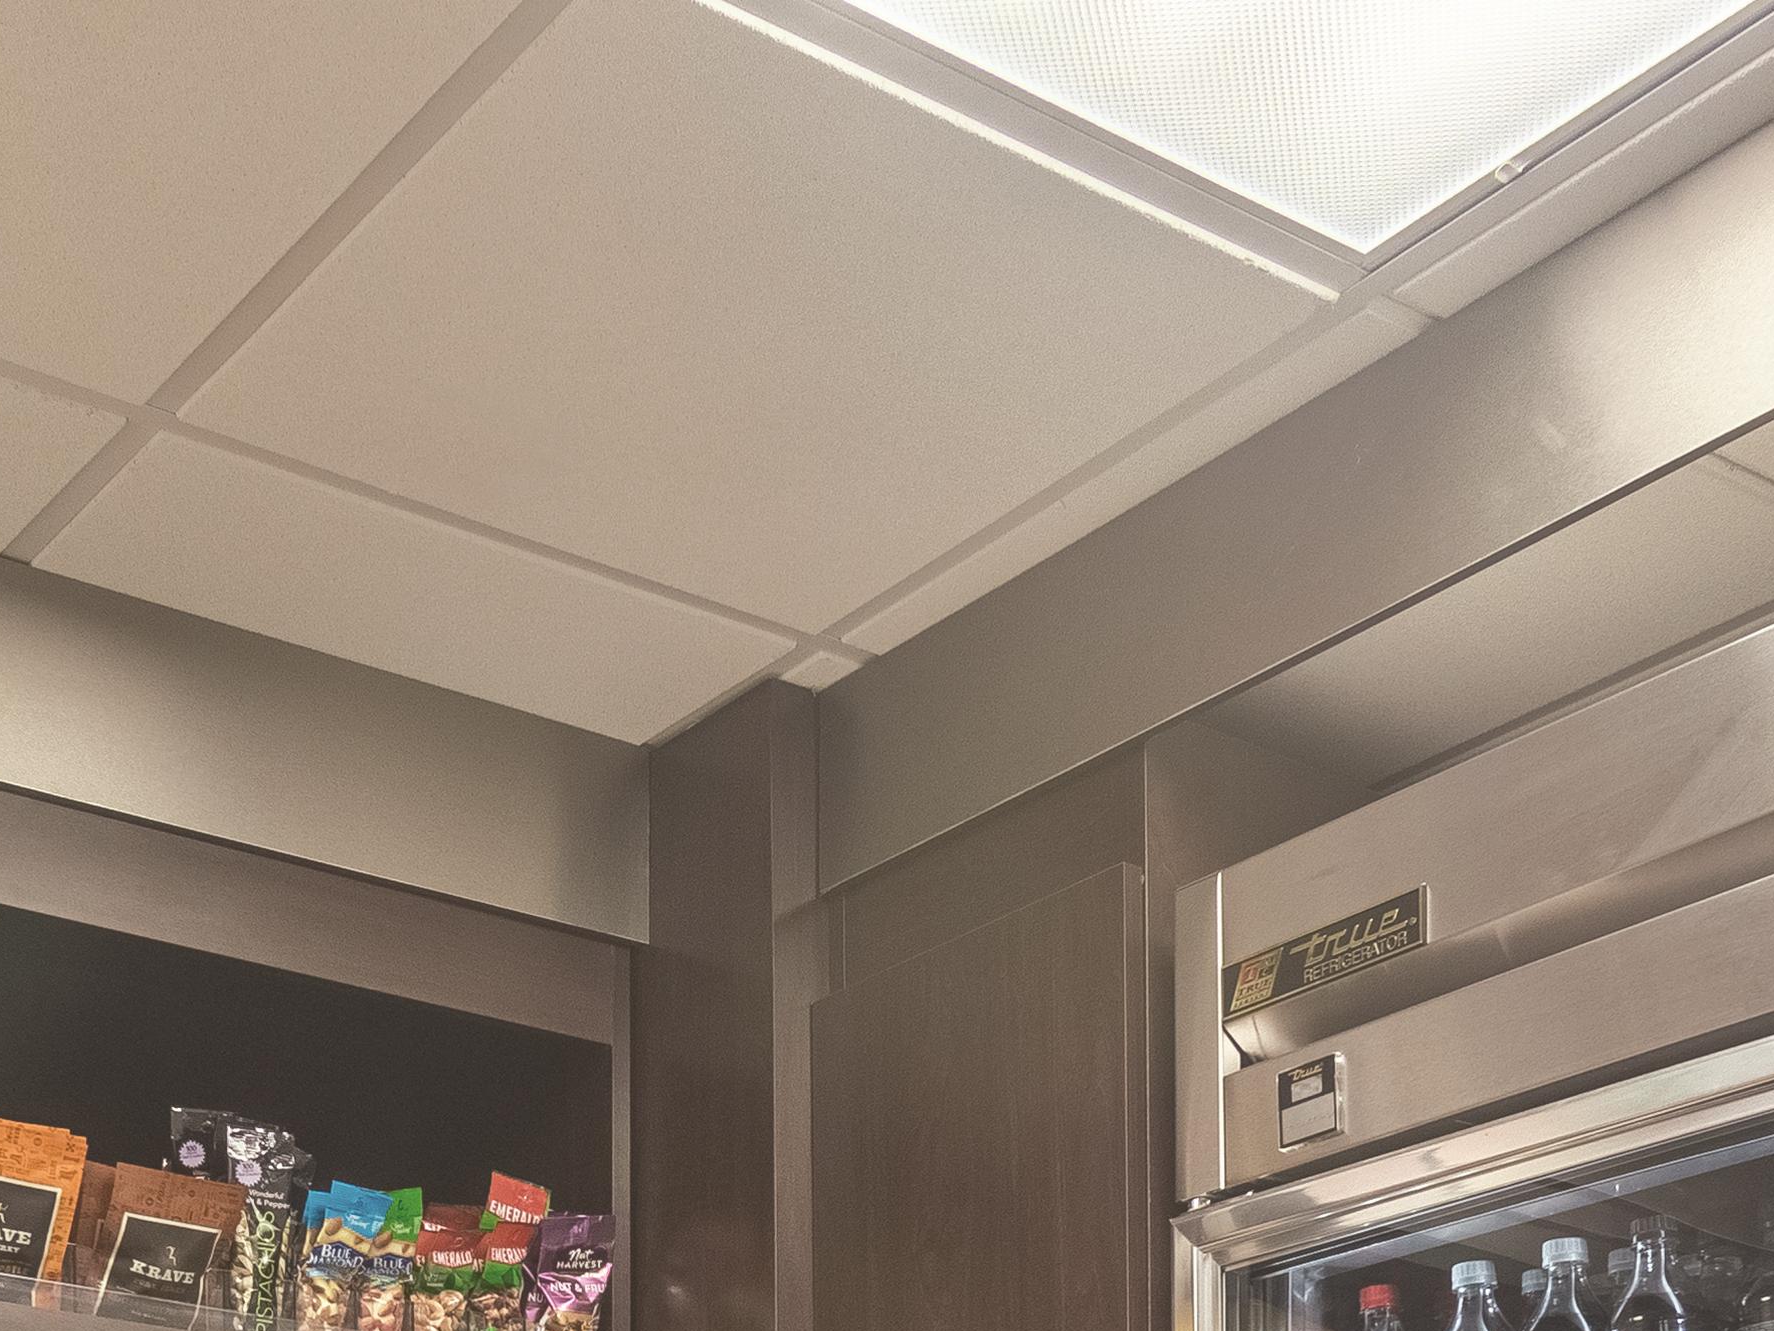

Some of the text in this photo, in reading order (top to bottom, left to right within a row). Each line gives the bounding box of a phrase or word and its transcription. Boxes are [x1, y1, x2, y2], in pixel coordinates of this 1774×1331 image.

[1303, 931, 1408, 984] REFRIGERATOR
[129, 1260, 194, 1285] KRAVE
[557, 1259, 603, 1270] HARVEST
